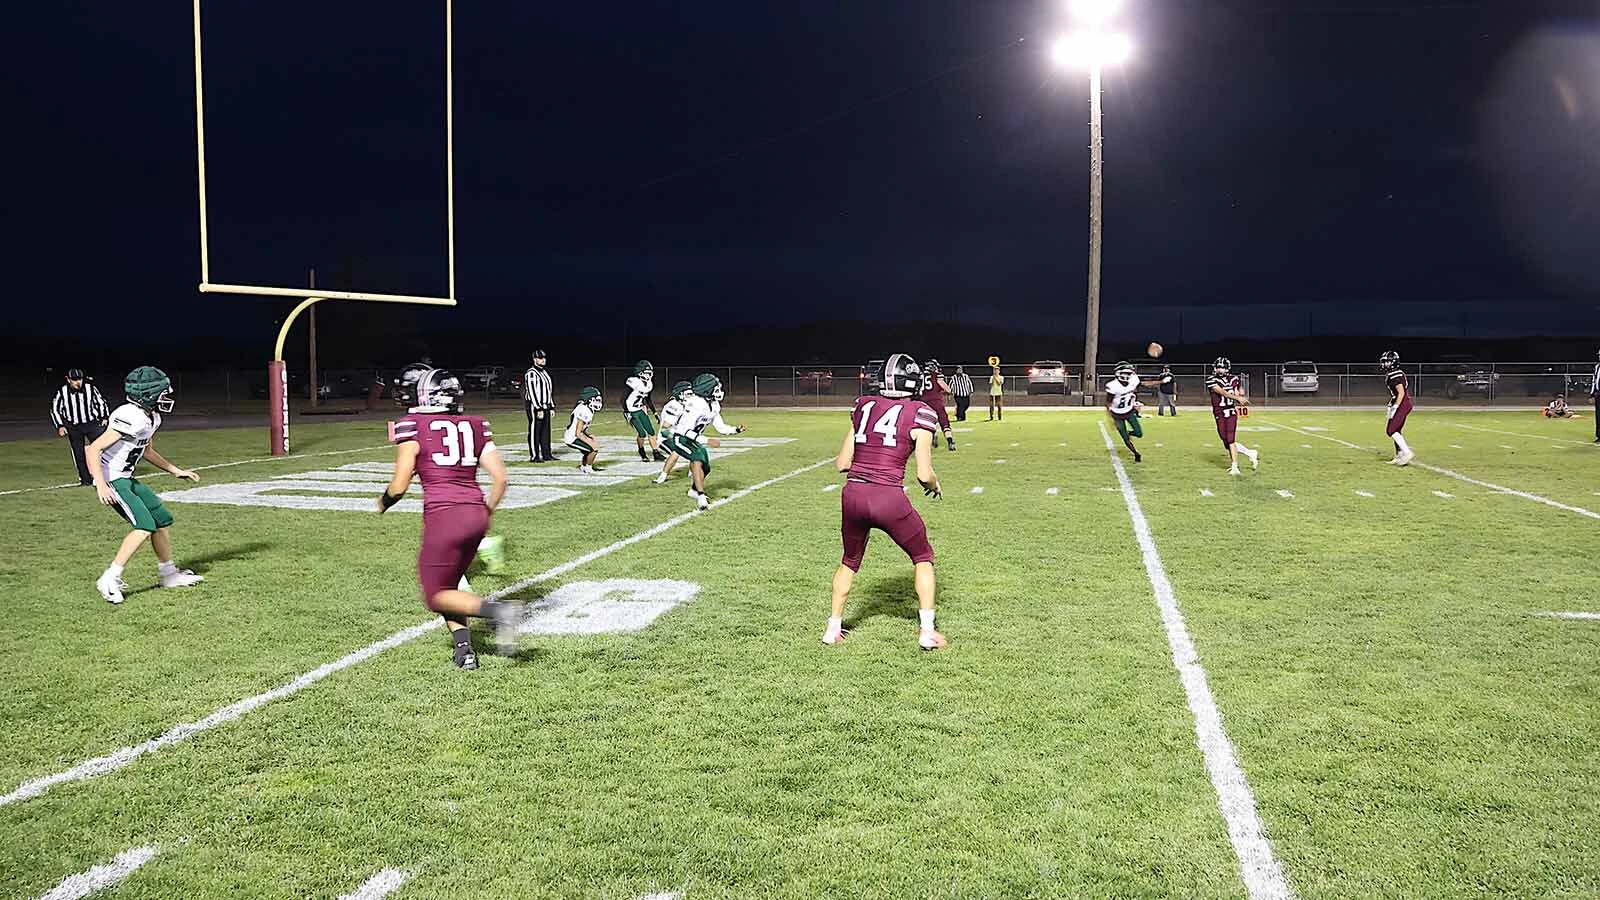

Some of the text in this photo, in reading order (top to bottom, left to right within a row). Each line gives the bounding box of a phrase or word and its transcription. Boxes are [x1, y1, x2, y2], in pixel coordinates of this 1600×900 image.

[991, 357, 997, 365] 3
[854, 400, 904, 447] 14
[1238, 407, 1248, 416] 10
[430, 419, 478, 467] 31
